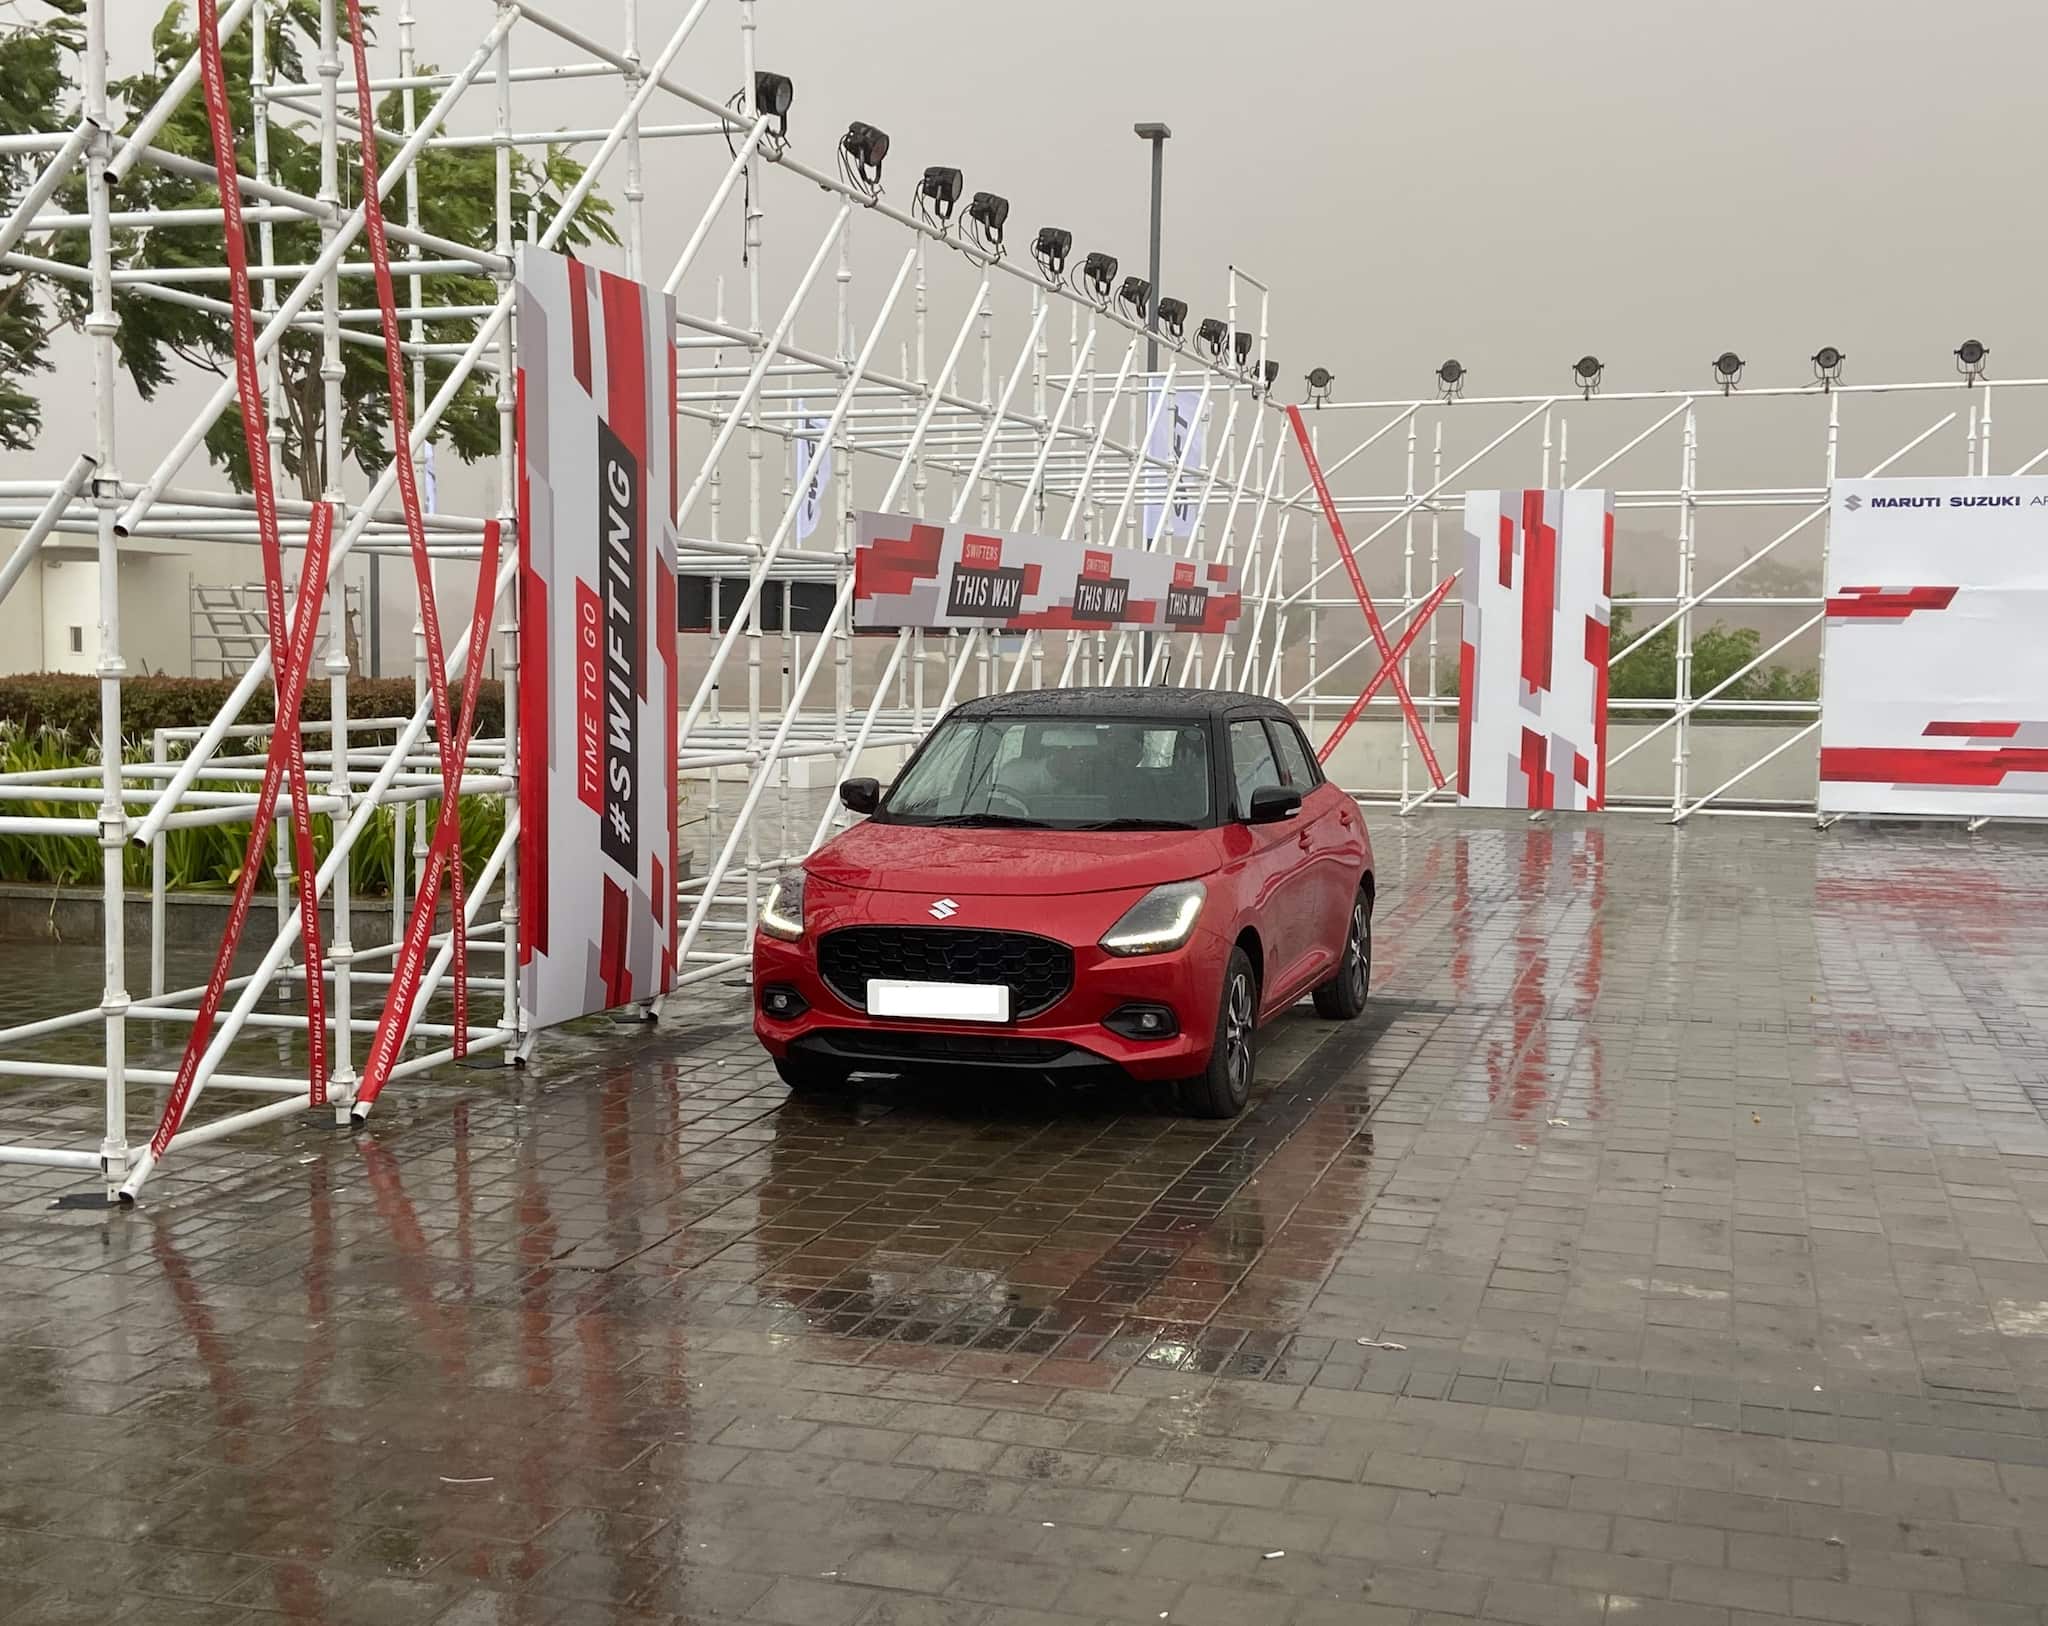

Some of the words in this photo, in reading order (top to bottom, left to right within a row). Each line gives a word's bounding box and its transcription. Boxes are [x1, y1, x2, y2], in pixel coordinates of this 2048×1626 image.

[216, 113, 231, 168] THRILL
[225, 174, 240, 231] INSIDE
[371, 222, 387, 272] INSIDE
[241, 355, 258, 429] EXTREME
[251, 432, 266, 486] THRILL
[260, 491, 274, 543] INSIDE
[400, 452, 412, 502] THRILL
[408, 504, 423, 550] INSIDE
[1871, 497, 1941, 508] MARUTI
[1950, 496, 2020, 507] SUZUKI
[966, 544, 998, 560] SWIFTERS
[271, 580, 284, 652] CAUTION:
[955, 574, 989, 606] THIS
[992, 578, 1020, 607] WAY
[1078, 585, 1102, 612] THIS
[1104, 587, 1126, 613] WAY
[1169, 593, 1187, 617] THIS
[1188, 595, 1205, 617] WAY
[282, 663, 300, 731] CAUTION:
[295, 595, 314, 662] EXTREME
[307, 550, 321, 596] THRILL
[584, 602, 597, 646] GO
[608, 460, 633, 844] #SWIFTING
[584, 661, 597, 700] TO
[584, 716, 598, 792] TIME
[296, 786, 308, 835] INSIDE
[231, 866, 253, 938] EXTREME
[251, 816, 267, 865] THRILL
[264, 761, 279, 812] INSIDE
[304, 871, 315, 937] CAUTION:
[308, 943, 321, 1008] EXTREME
[374, 1013, 399, 1082] CAUTION:
[394, 950, 418, 1013] EXTREME
[412, 902, 431, 952] THRILL
[313, 1012, 322, 1059] THRILL
[175, 1049, 197, 1104] INSIDE
